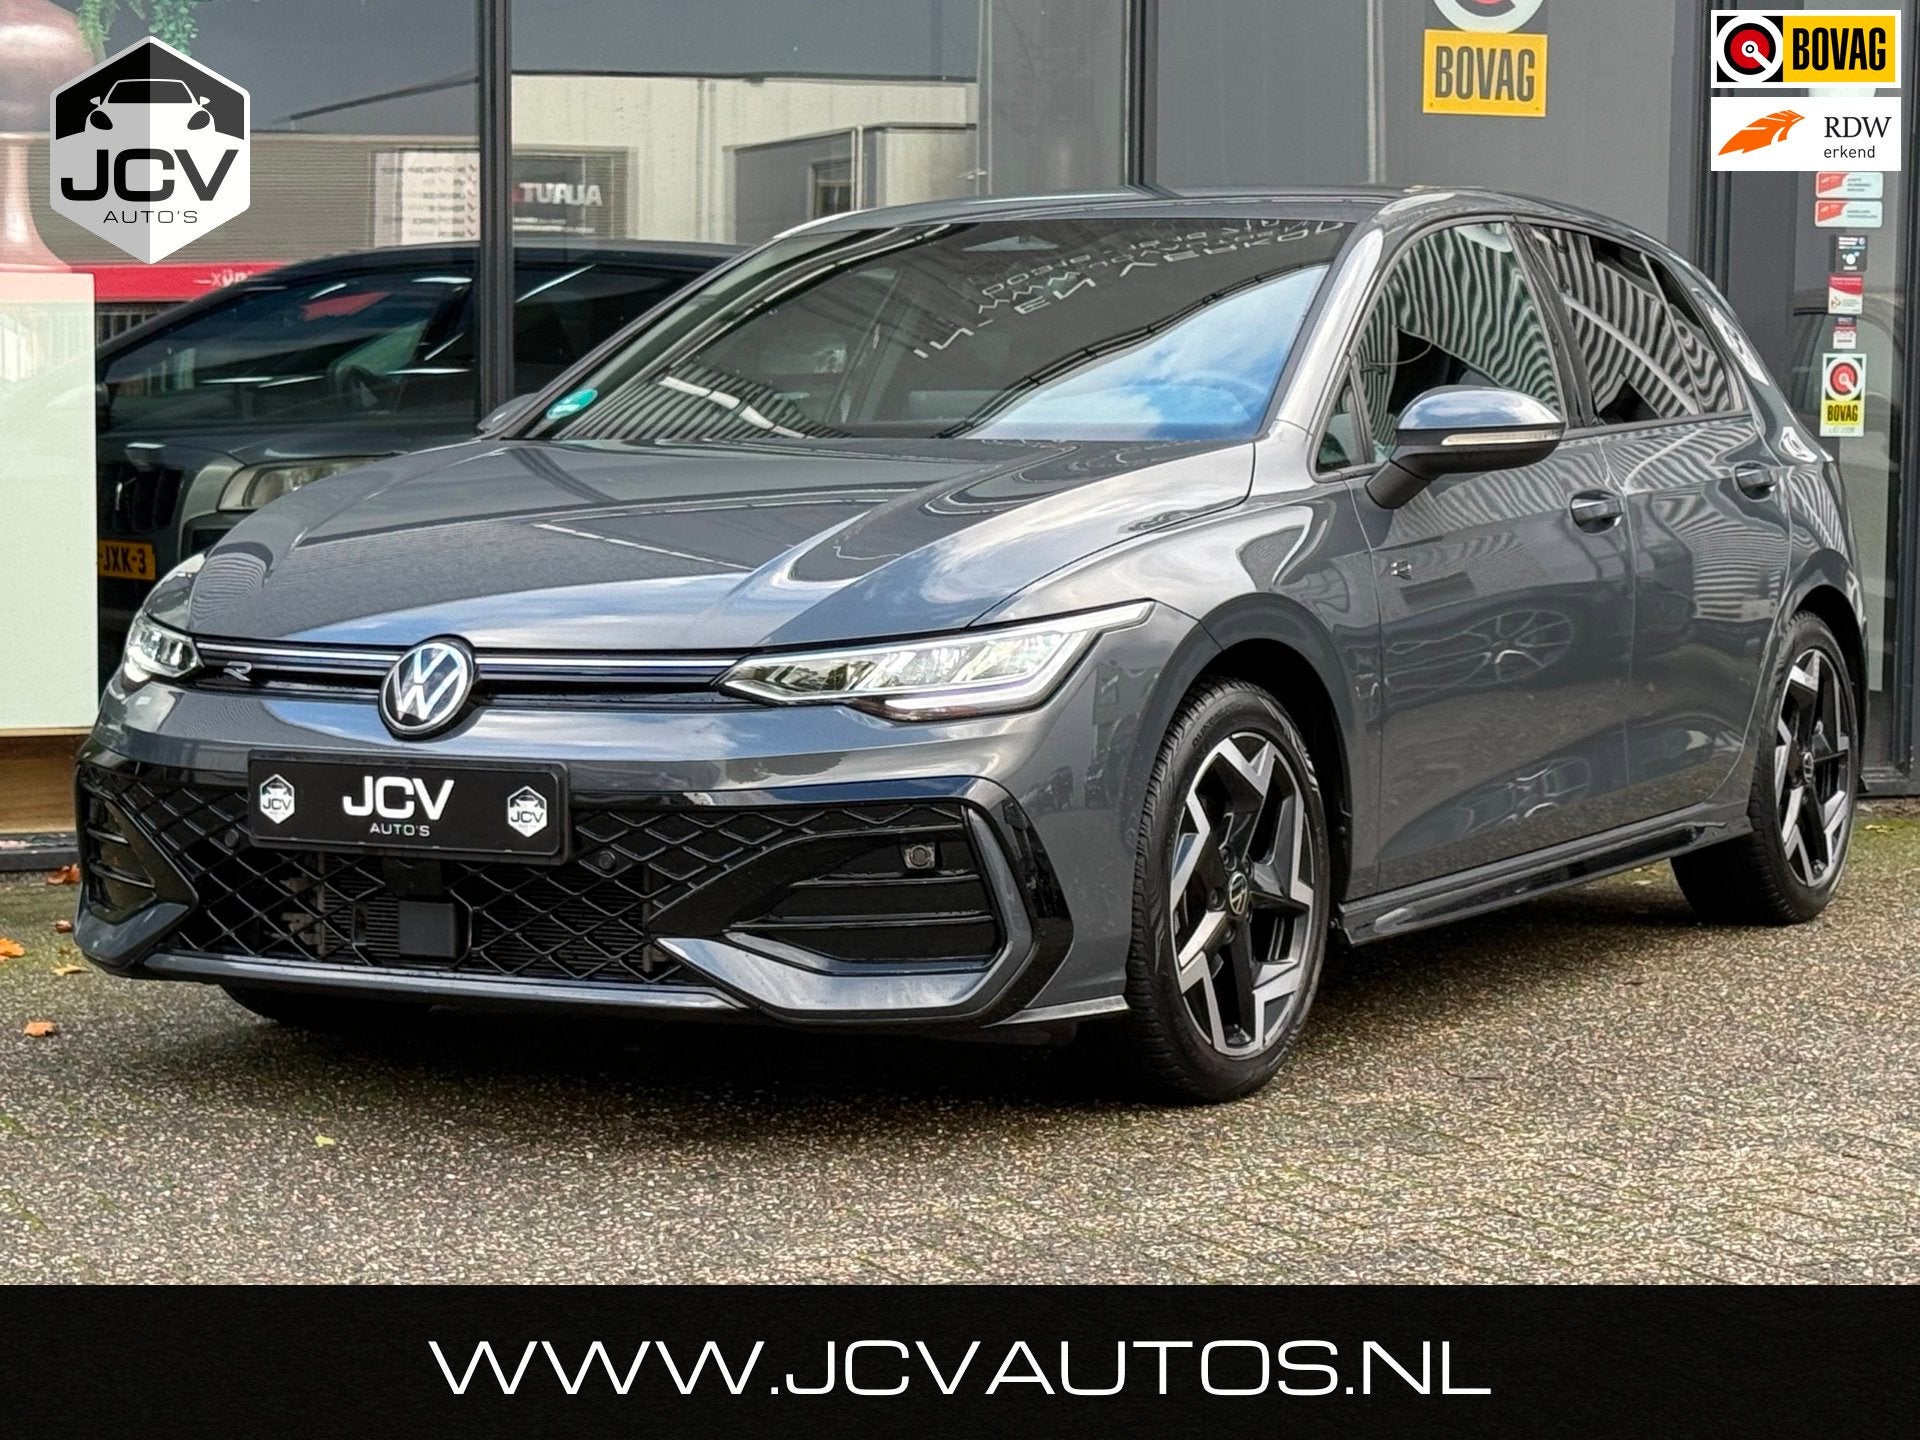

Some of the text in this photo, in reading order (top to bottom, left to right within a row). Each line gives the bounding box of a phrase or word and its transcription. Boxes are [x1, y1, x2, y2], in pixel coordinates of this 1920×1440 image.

[1435, 46, 1535, 102] BOVAG
[1827, 405, 1858, 422] BOVAG
[263, 798, 292, 811] JCV
[342, 775, 455, 821] JCV
[510, 810, 544, 823] JCV
[369, 822, 430, 837] AUTO'S
